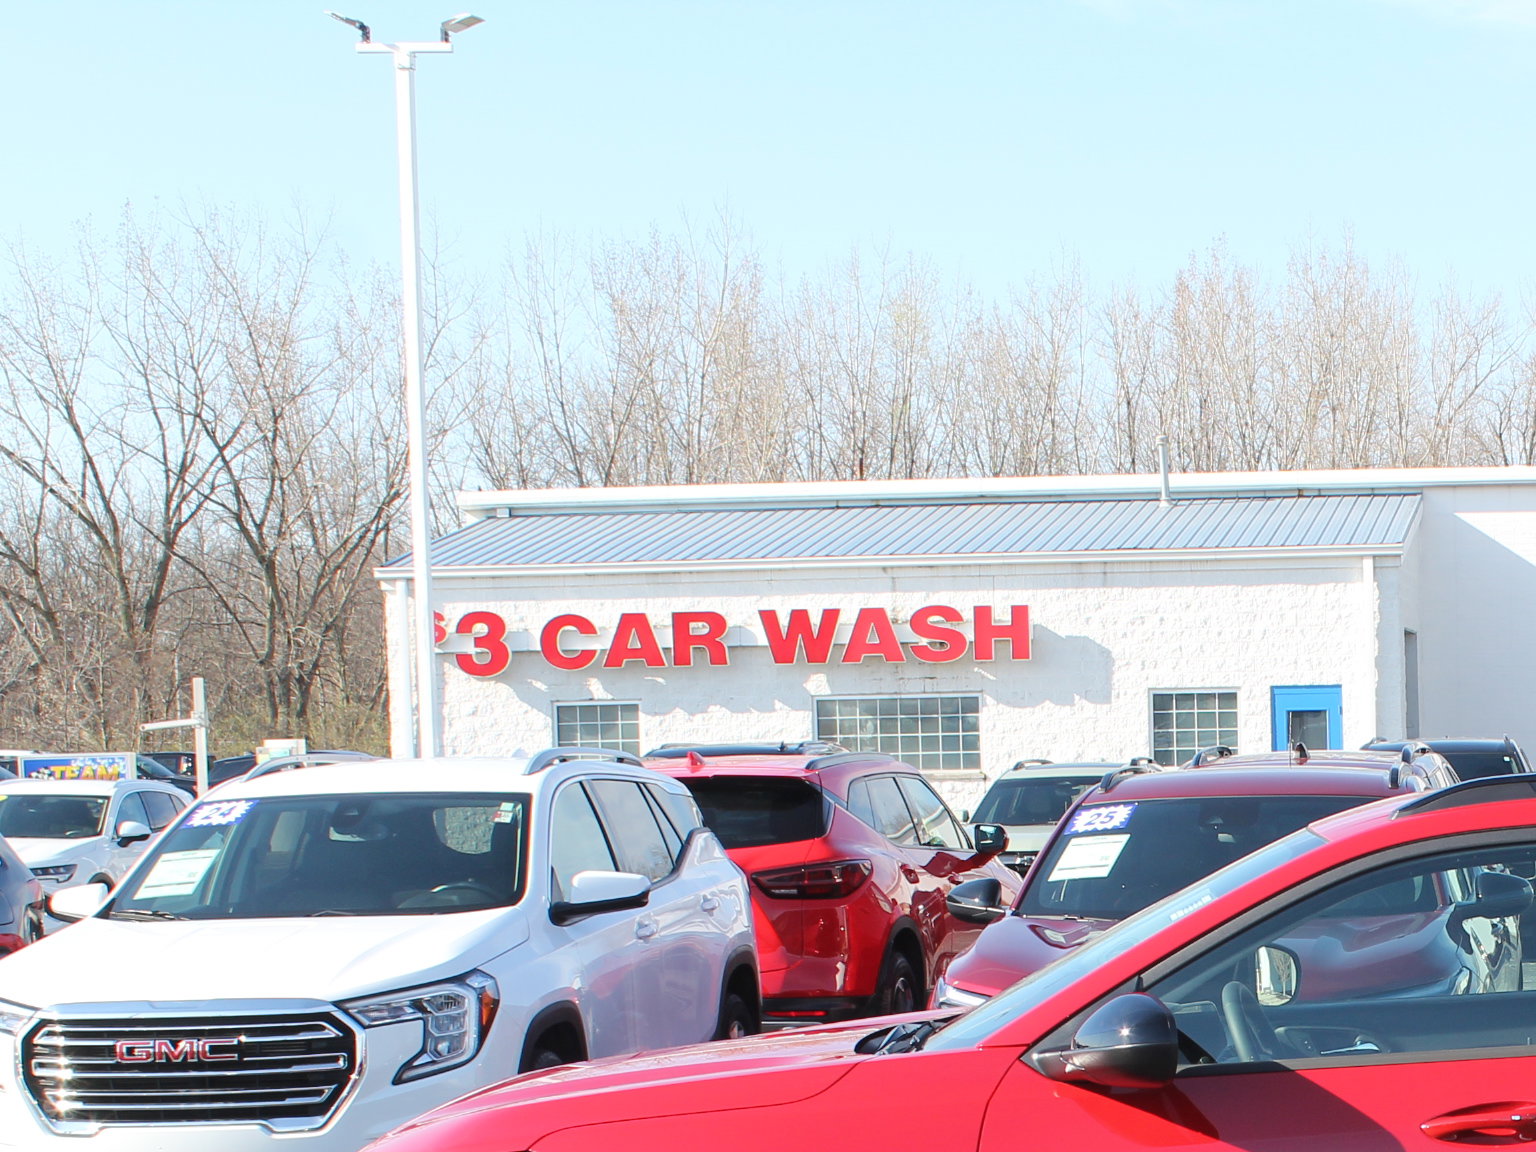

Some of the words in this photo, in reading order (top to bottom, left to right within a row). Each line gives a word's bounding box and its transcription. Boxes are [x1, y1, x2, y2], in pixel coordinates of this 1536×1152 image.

[539, 610, 730, 670] CAR
[757, 604, 1032, 666] WASH
[49, 764, 121, 780] TEAM
[1084, 810, 1118, 826] 25
[114, 1038, 239, 1063] GMC
